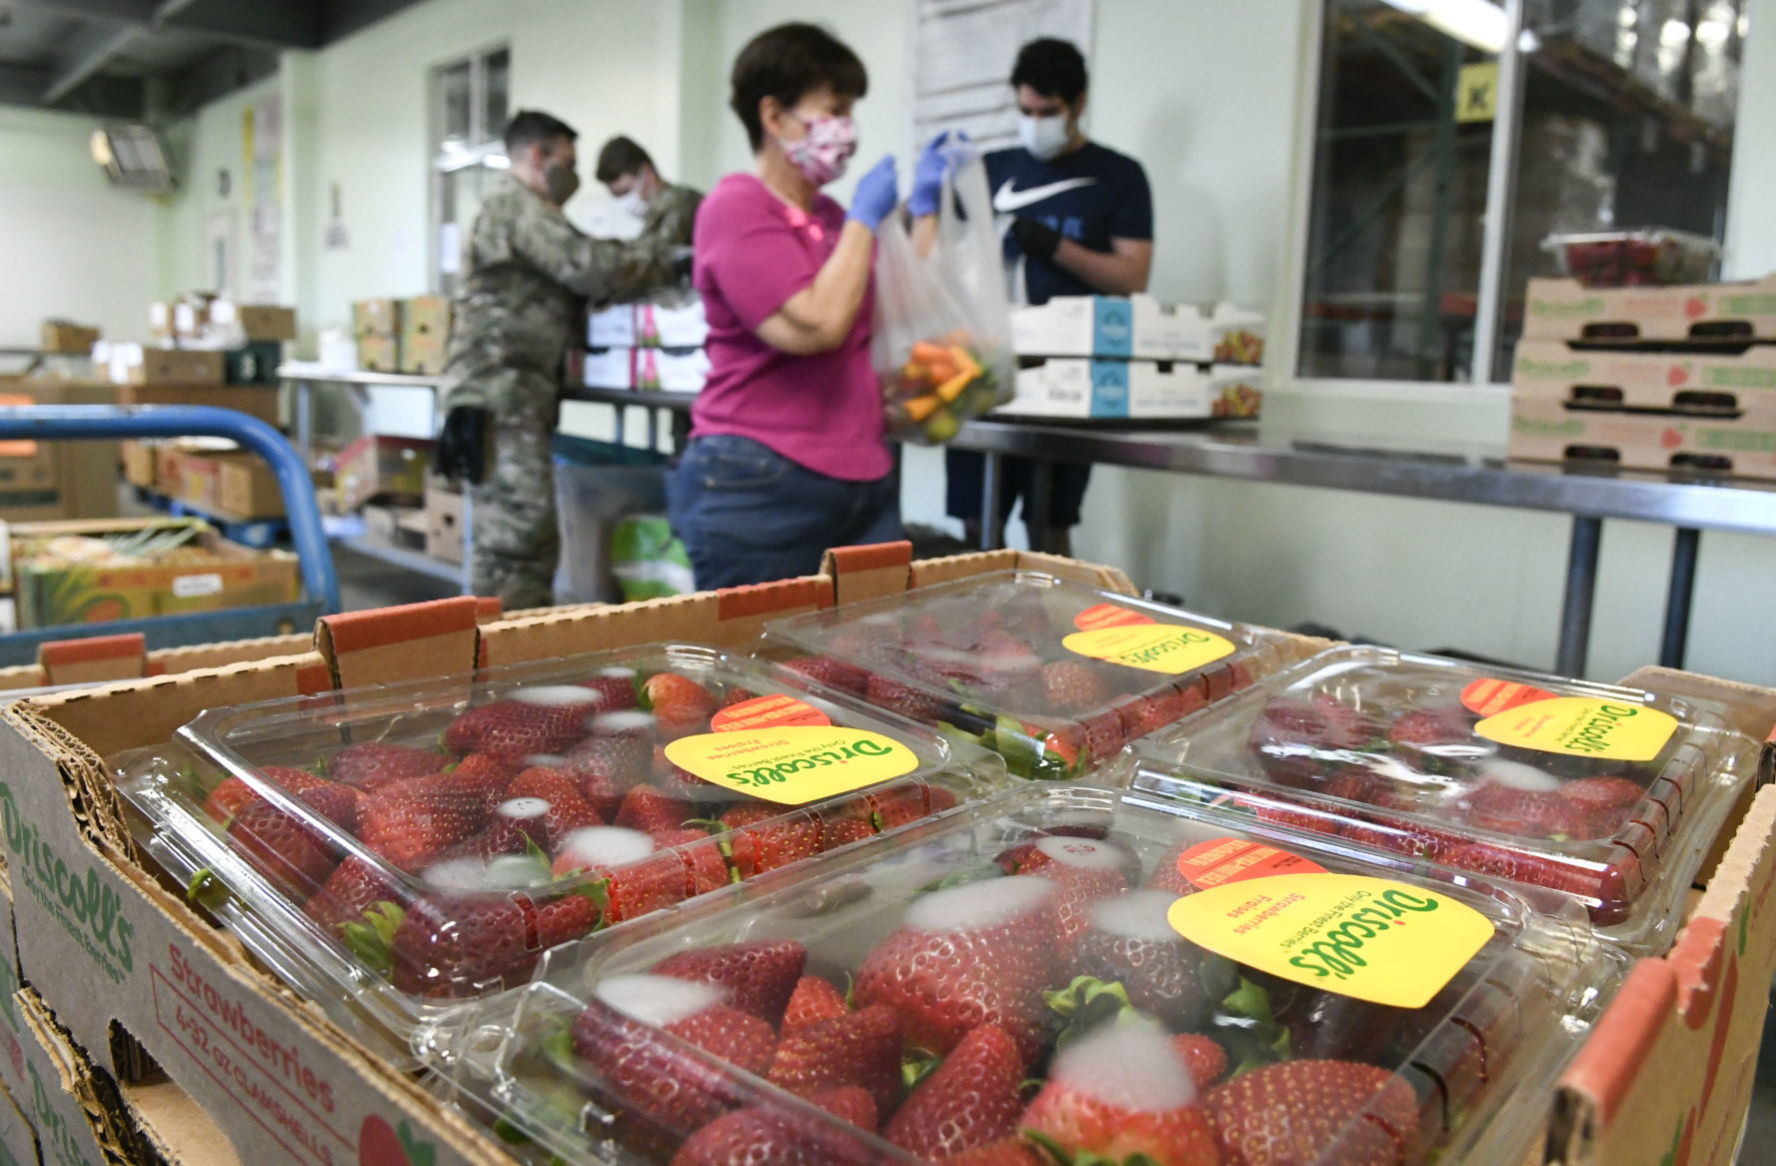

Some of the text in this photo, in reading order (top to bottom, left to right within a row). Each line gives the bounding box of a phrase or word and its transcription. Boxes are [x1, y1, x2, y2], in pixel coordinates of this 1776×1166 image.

[1564, 705, 1638, 753] Driscoll's
[726, 740, 893, 787] Driscoll's
[0, 782, 134, 973] Driscoll's
[1226, 894, 1272, 918] Fraises
[1233, 892, 1306, 935] Strawberries
[1279, 890, 1372, 948] Only the Finest Berries
[1288, 889, 1439, 980] Driscoll's
[168, 943, 336, 1113] Strawberries
